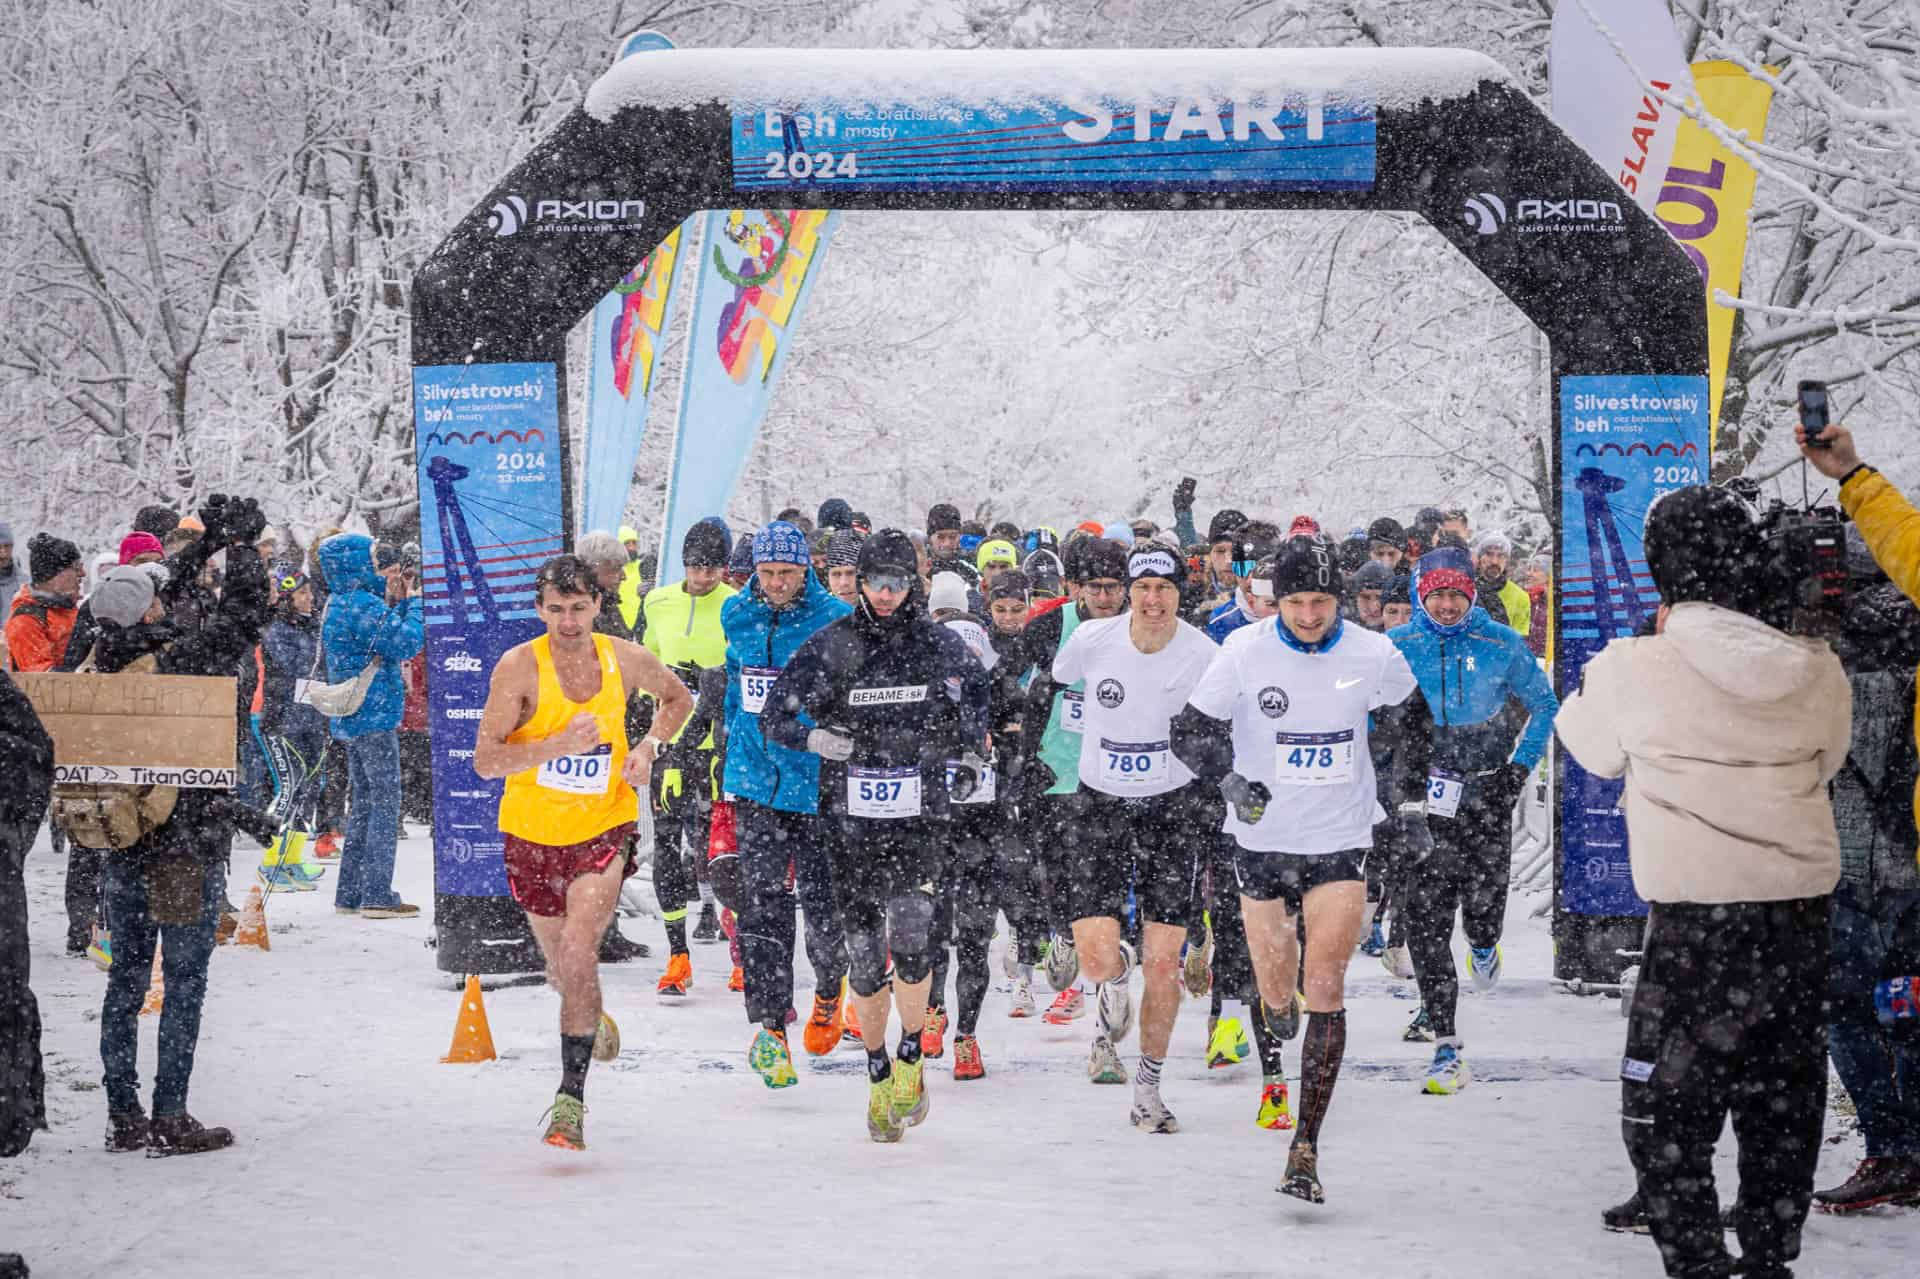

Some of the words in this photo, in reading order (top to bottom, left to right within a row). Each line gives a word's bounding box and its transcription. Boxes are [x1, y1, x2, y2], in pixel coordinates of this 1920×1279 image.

[764, 107, 836, 137] beh
[844, 121, 898, 141] mosty
[765, 151, 858, 179] 2024
[537, 200, 645, 220] AXION
[1517, 199, 1623, 220] AXION
[537, 223, 642, 233] axion4event.com
[1517, 223, 1624, 233] axion4event.com
[423, 379, 544, 400] Silvestrovský
[424, 406, 453, 421] beh
[1574, 393, 1699, 415] Silvestrovský
[1575, 416, 1610, 432] beh
[496, 452, 545, 471] 2024
[1653, 466, 1699, 484] 2024
[546, 756, 600, 777] 1010
[1108, 752, 1152, 772] 780
[1287, 747, 1334, 769] 478
[130, 768, 237, 786] TitanGOAT
[860, 781, 902, 801] 587
